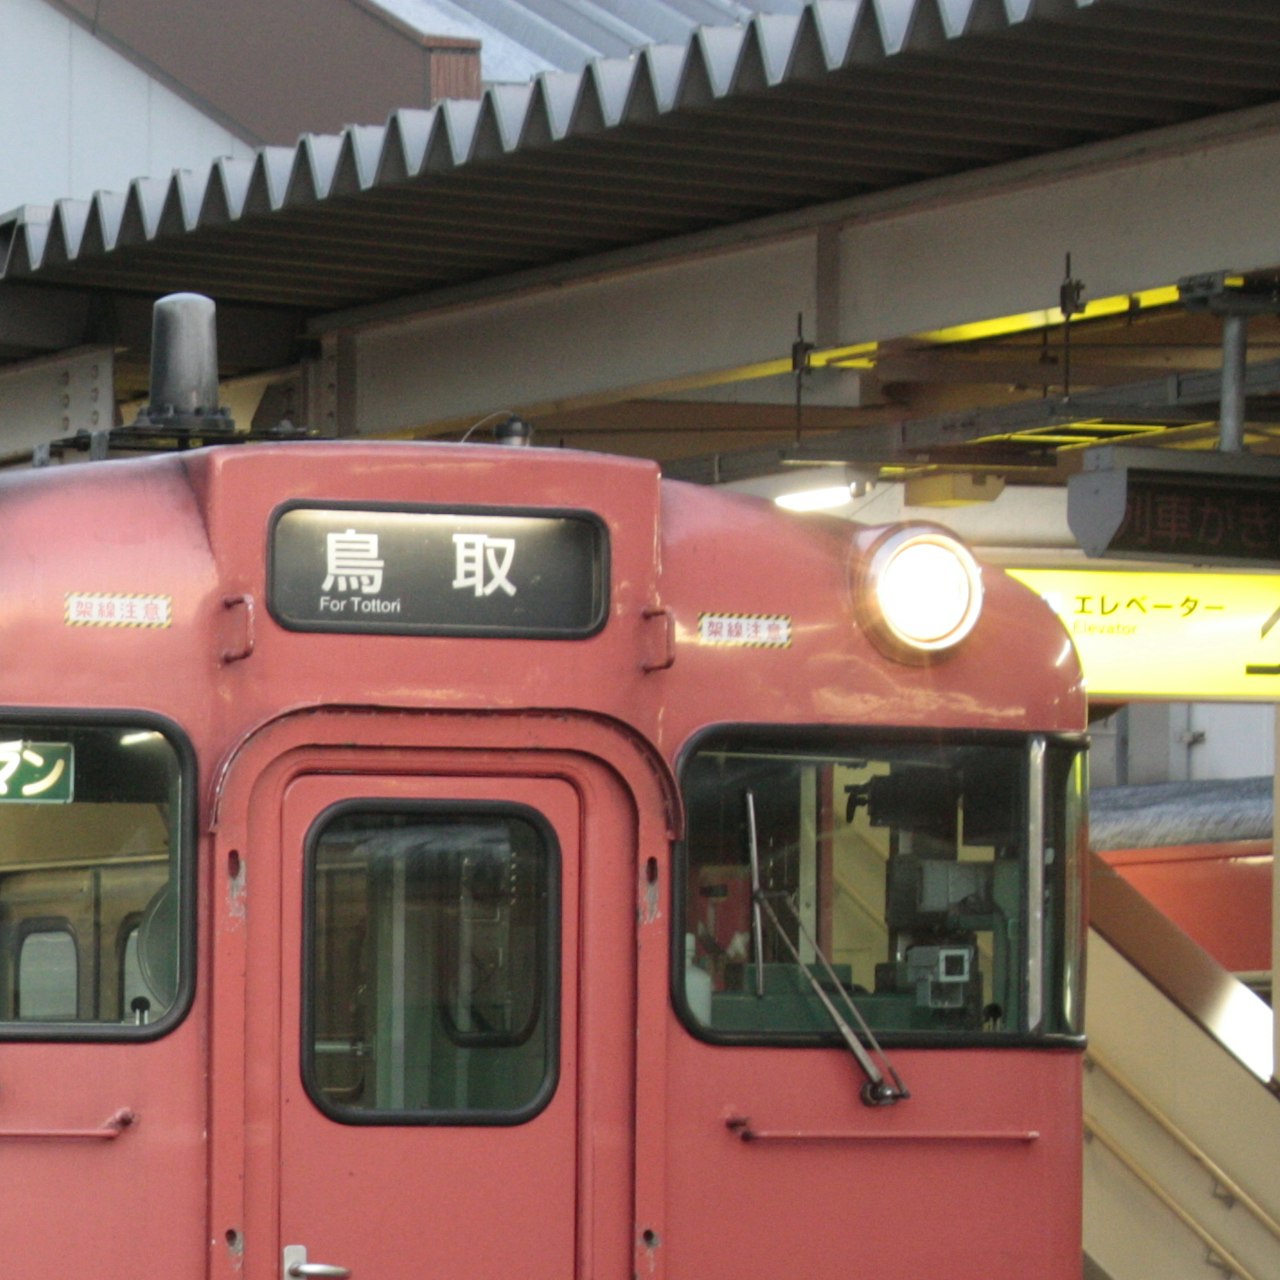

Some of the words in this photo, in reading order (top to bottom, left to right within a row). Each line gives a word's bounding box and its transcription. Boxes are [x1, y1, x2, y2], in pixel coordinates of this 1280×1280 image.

[321, 529, 517, 597] 鳥取
[75, 600, 161, 621] 架線注意
[319, 596, 347, 612] For
[351, 597, 401, 613] Tottori
[1075, 596, 1225, 617] エレベーター
[707, 620, 781, 641] 架線注意
[1073, 622, 1137, 636] Elevator
